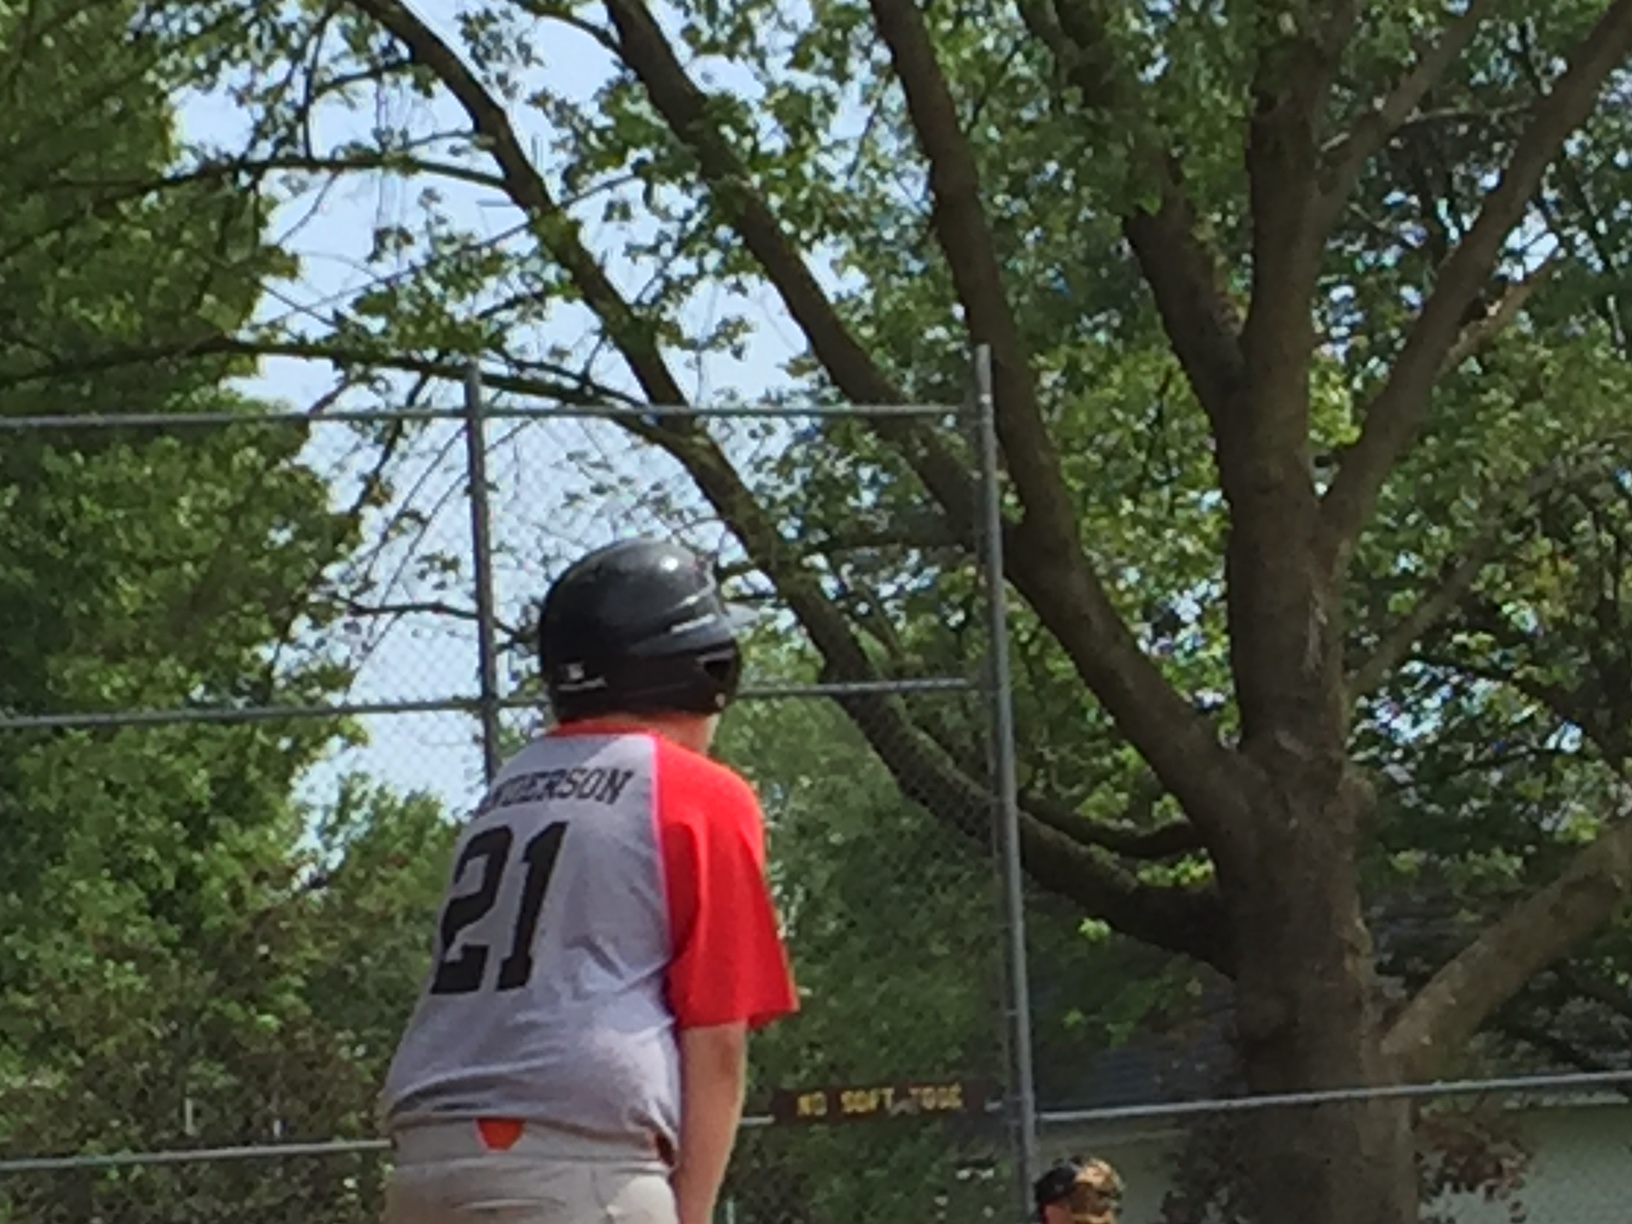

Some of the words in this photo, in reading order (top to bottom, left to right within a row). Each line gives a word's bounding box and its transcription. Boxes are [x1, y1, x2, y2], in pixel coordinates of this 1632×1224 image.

[430, 821, 569, 995] 21
[798, 1092, 826, 1116] NO
[841, 1088, 894, 1113] SOFT
